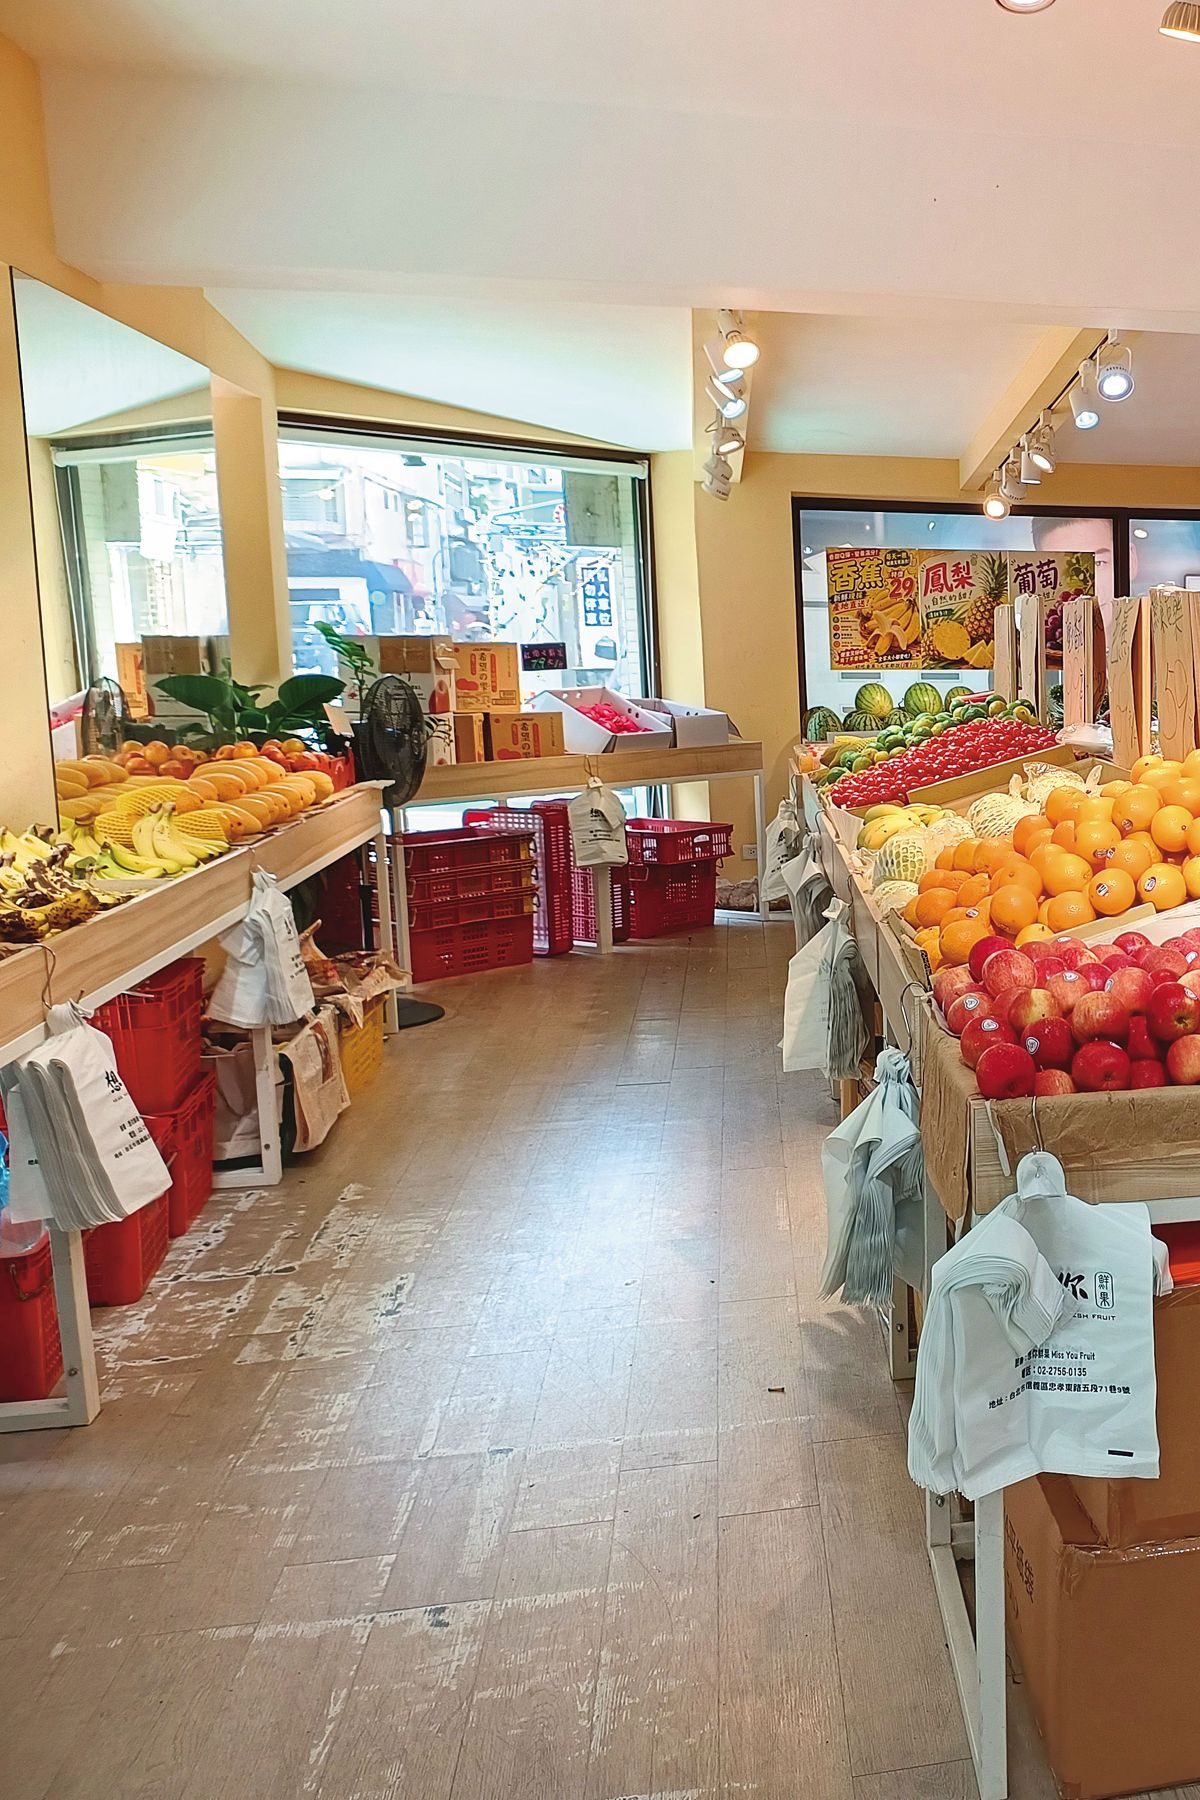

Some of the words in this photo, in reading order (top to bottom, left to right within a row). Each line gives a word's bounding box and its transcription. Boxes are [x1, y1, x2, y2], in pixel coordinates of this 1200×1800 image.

[831, 558, 883, 592] 香蕉
[889, 577, 914, 599] 29
[923, 560, 976, 597] 鳳梨
[1013, 558, 1059, 595] 葡萄
[931, 589, 974, 606] 自然的甜!
[1097, 1274, 1112, 1307] 鮮果
[1091, 1313, 1117, 1321] FRUIT
[1051, 1350, 1065, 1360] Miss
[1066, 1350, 1079, 1360] You
[1079, 1351, 1096, 1361] Fruit
